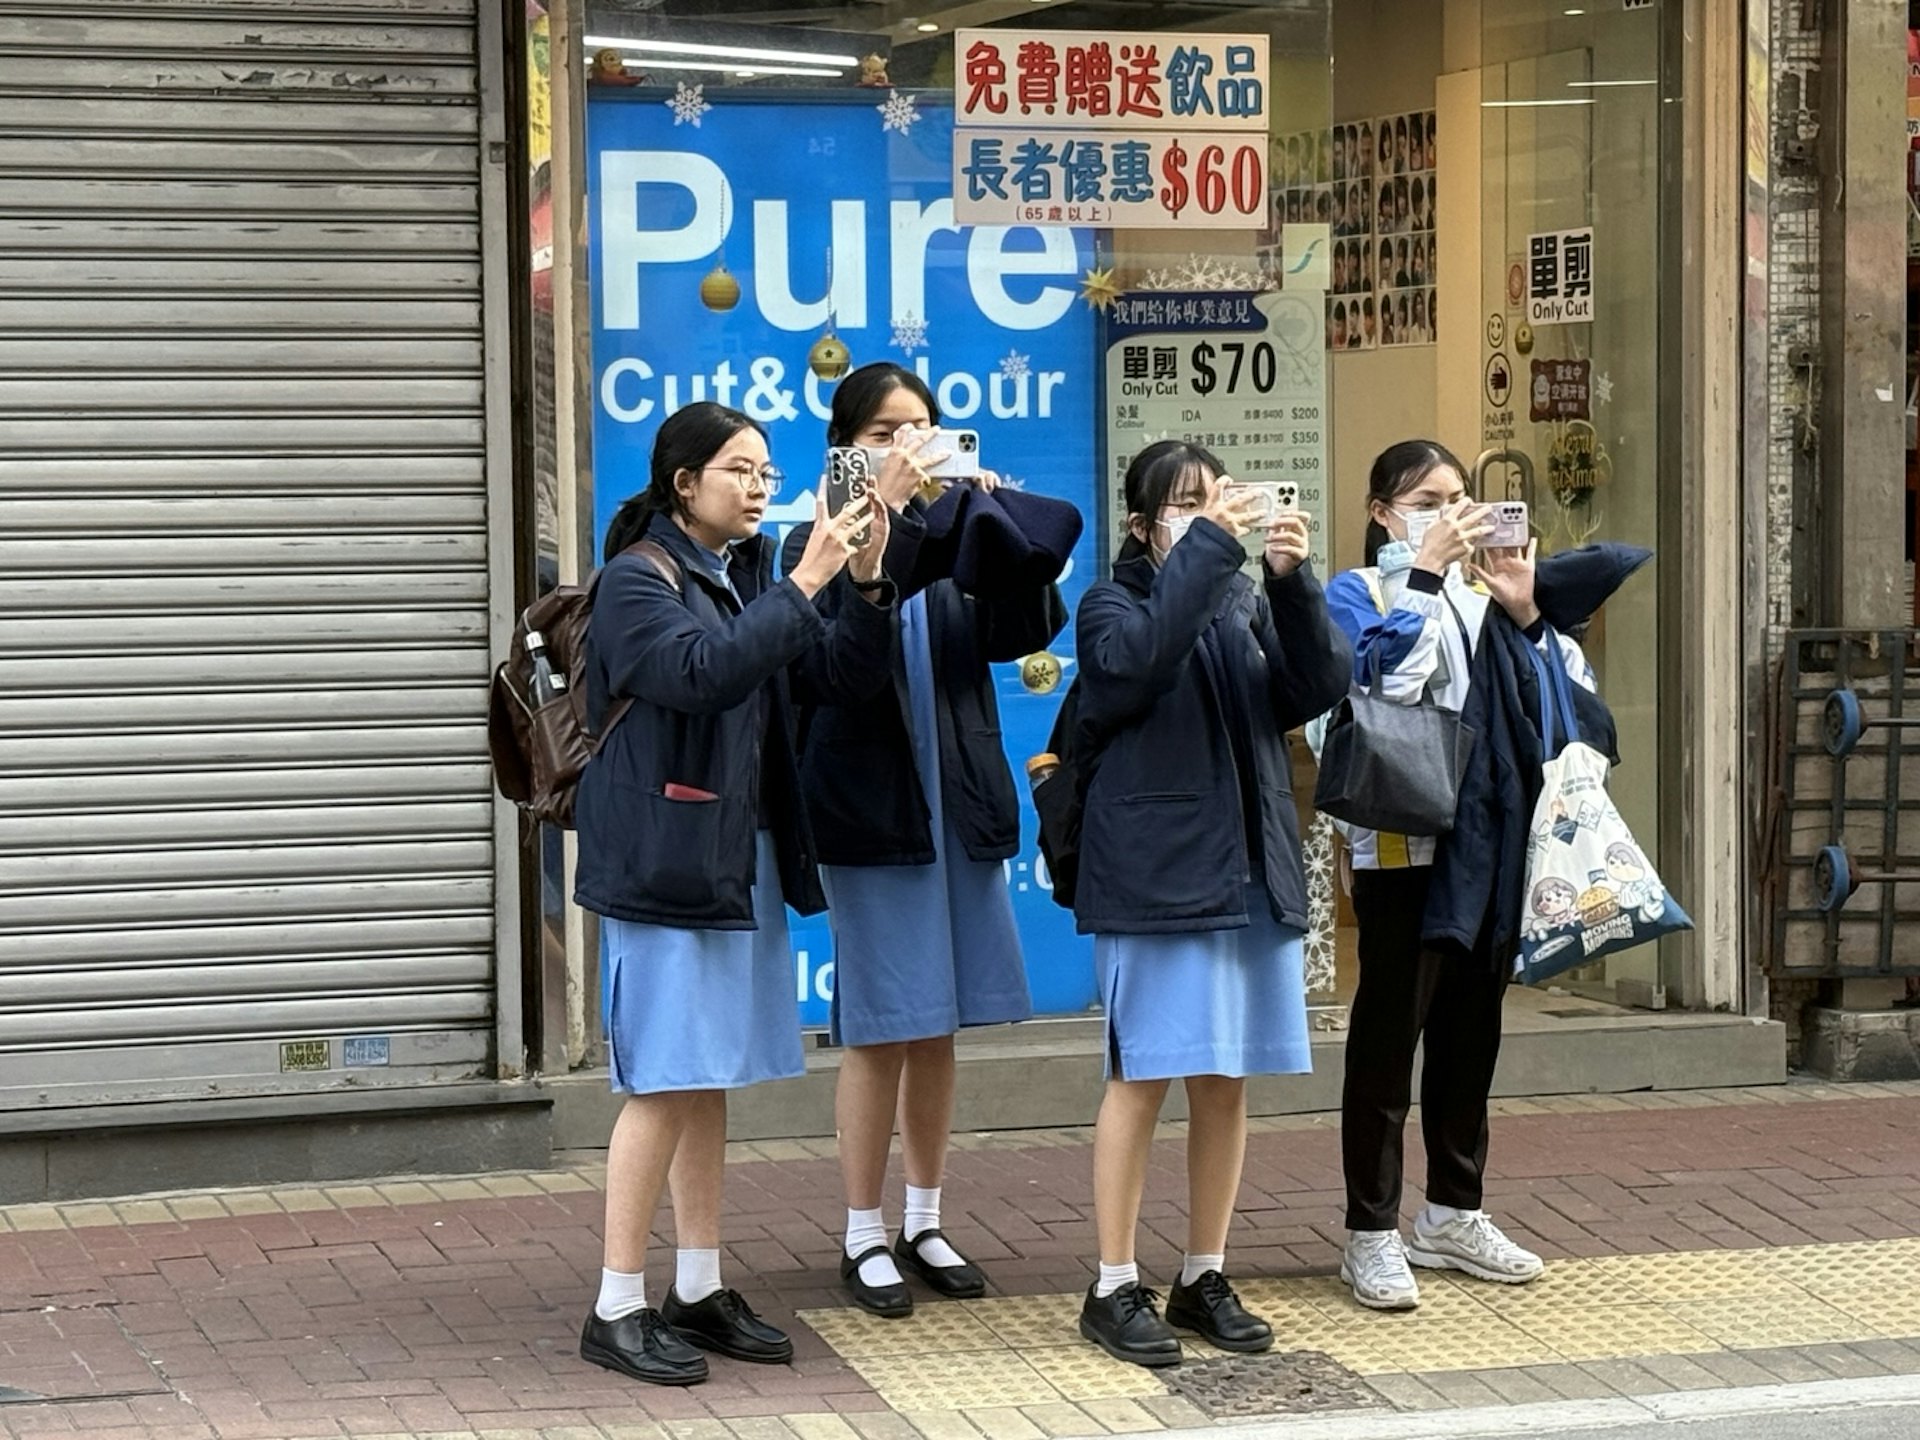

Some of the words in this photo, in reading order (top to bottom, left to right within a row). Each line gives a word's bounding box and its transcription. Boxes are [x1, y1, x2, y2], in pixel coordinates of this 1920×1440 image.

[965, 40, 1262, 118] 免費贈送飲品
[961, 138, 1154, 203] 長者優惠
[1160, 138, 1262, 219] $60
[600, 150, 1078, 332] Pure
[1531, 233, 1591, 299] 單剪
[1113, 299, 1250, 325] 我們給你專業意見
[1533, 302, 1563, 320] Only
[1566, 300, 1589, 316] Cut
[1123, 346, 1178, 381] 單剪
[1191, 340, 1276, 397] $70
[1122, 382, 1152, 398] Only
[1155, 382, 1178, 396] Cut
[1116, 419, 1145, 429] Colour
[1181, 410, 1201, 422] IDA
[1291, 407, 1319, 420] $200
[1291, 431, 1319, 444] $350
[1291, 457, 1319, 470] $350
[1299, 489, 1319, 501] 650
[1581, 913, 1631, 941] MOVING
